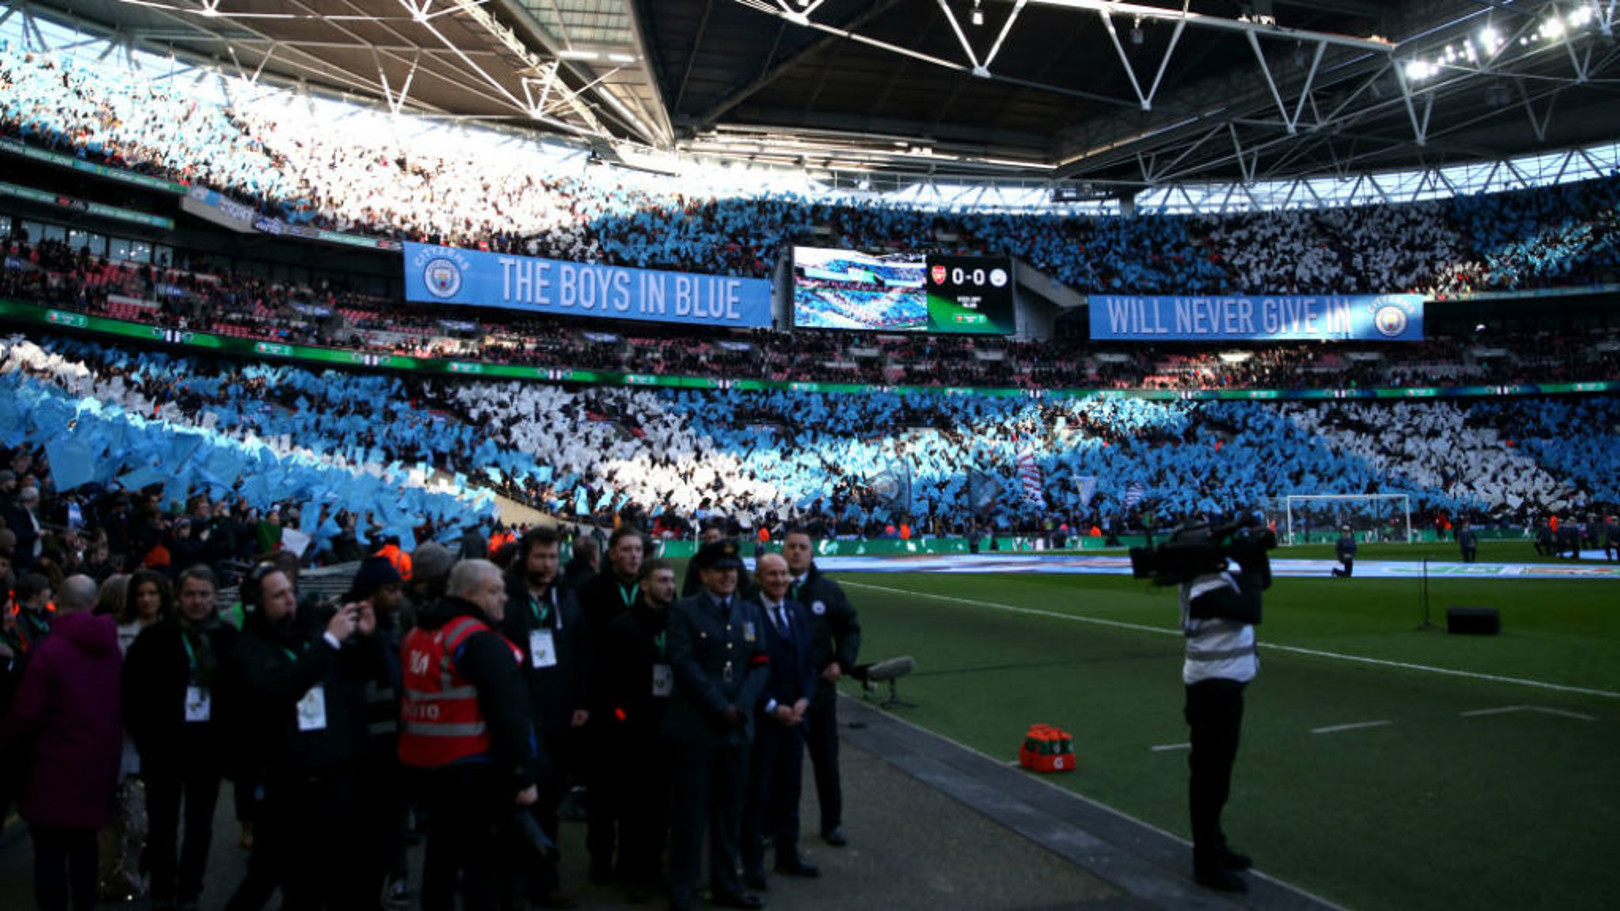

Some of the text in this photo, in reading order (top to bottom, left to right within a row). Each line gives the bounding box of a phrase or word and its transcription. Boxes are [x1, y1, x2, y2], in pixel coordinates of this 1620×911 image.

[498, 257, 741, 319] THE BOYS IN BLUE
[952, 267, 986, 286] 0-0
[1106, 297, 1351, 334] WILL NEVER GIVE IN
